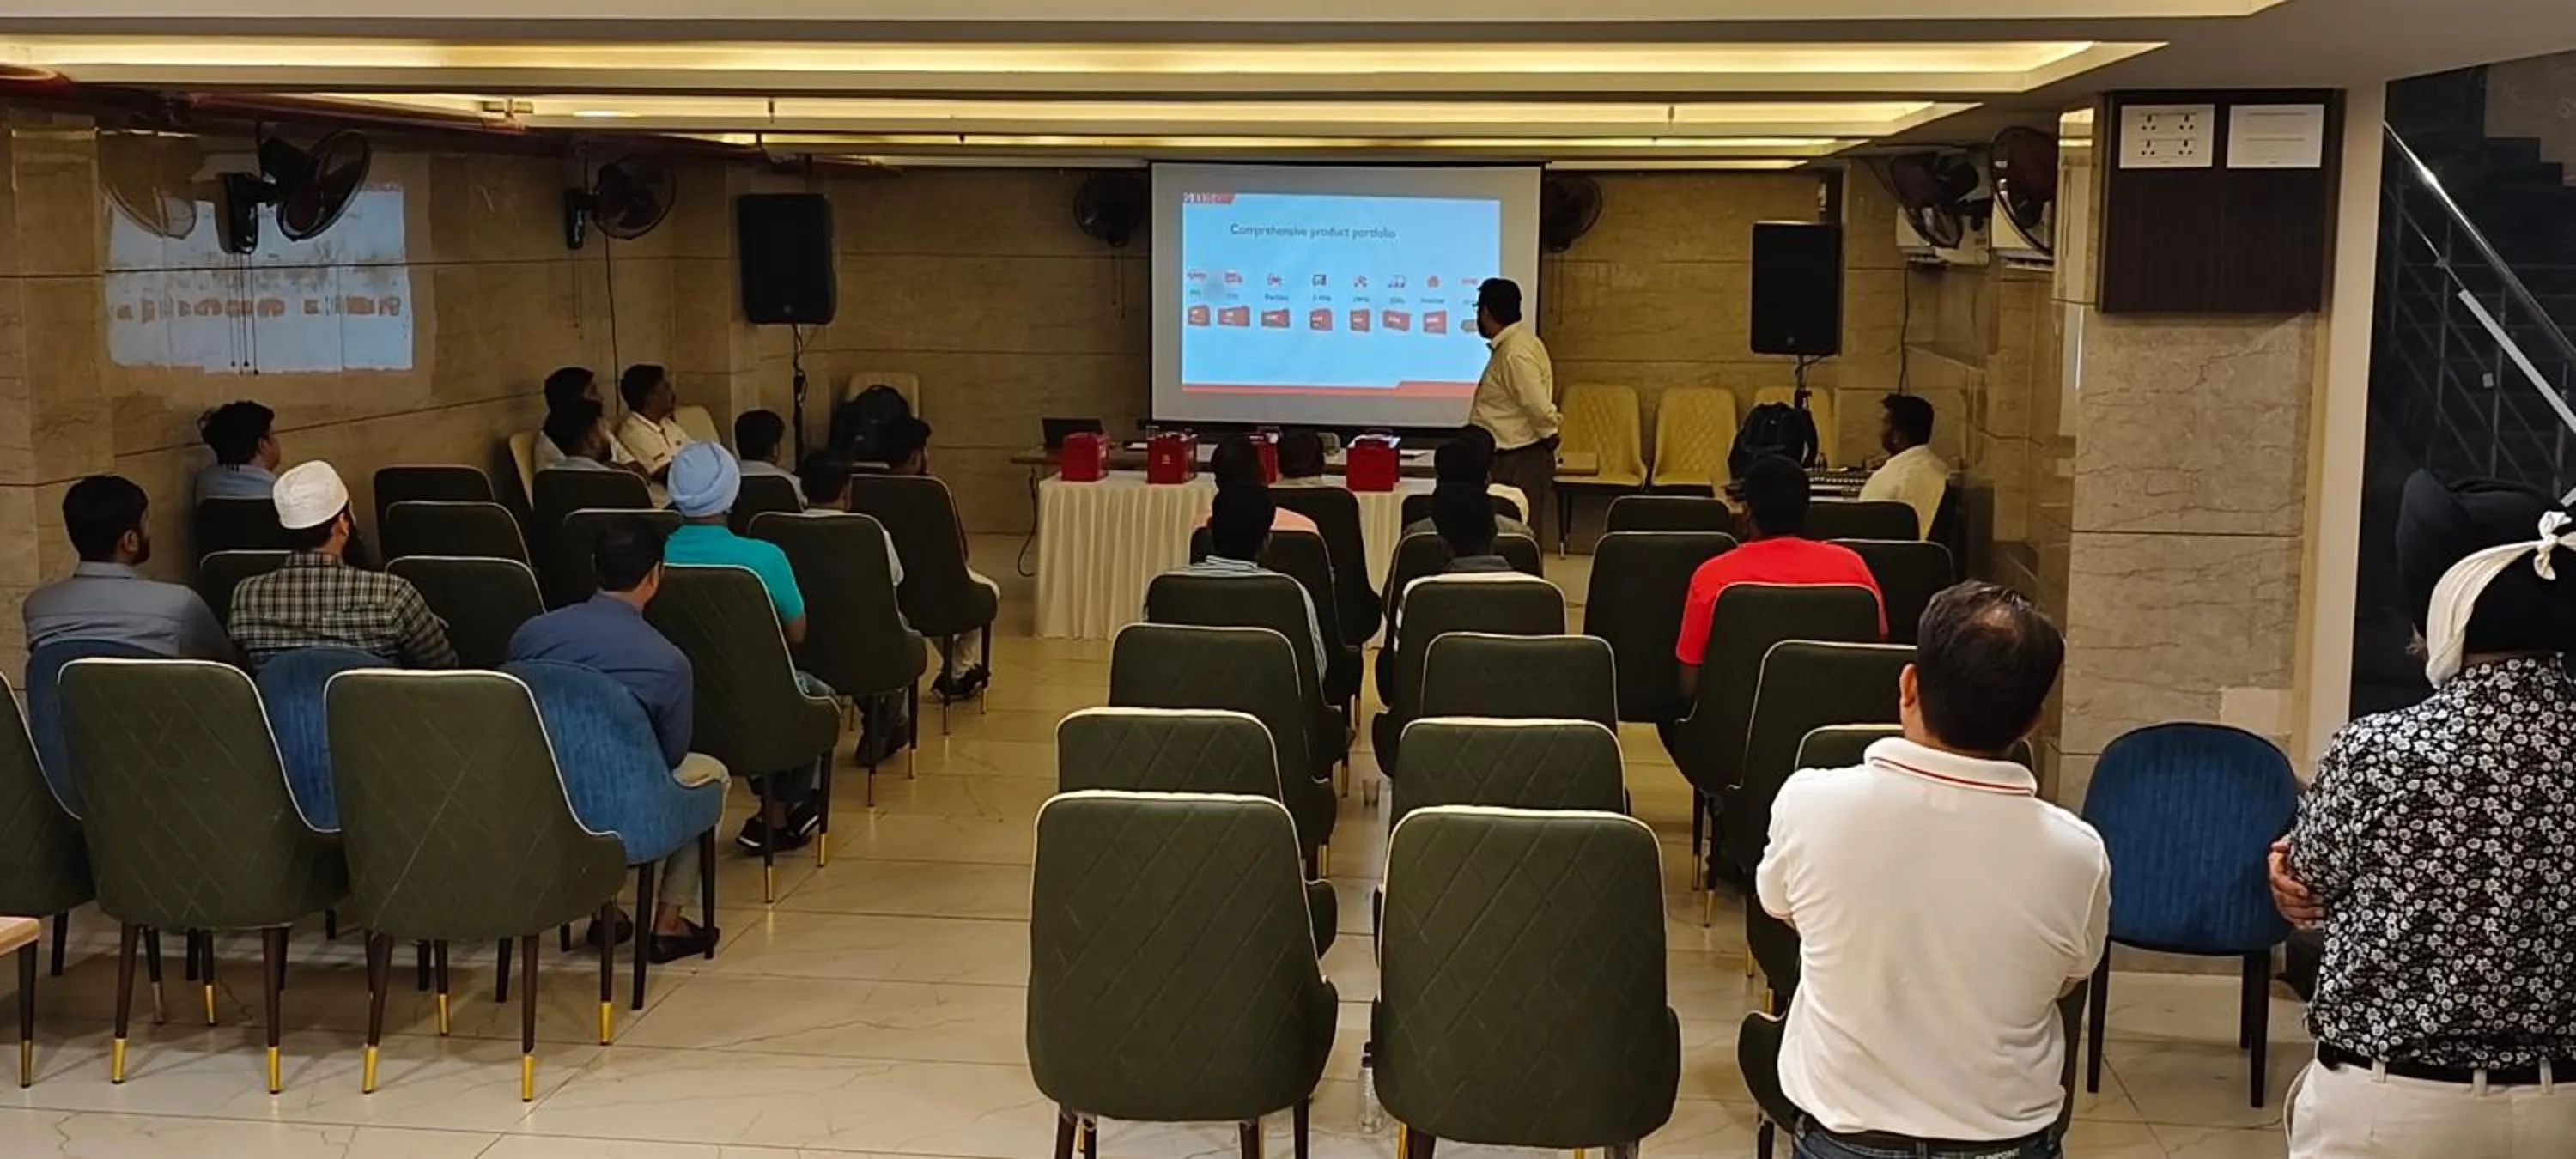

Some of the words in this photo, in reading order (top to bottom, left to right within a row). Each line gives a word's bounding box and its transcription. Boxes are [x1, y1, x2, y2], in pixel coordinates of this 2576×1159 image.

[1230, 223, 1307, 238] Comprehensive
[1309, 227, 1350, 240] product
[1352, 228, 1397, 240] portfolio
